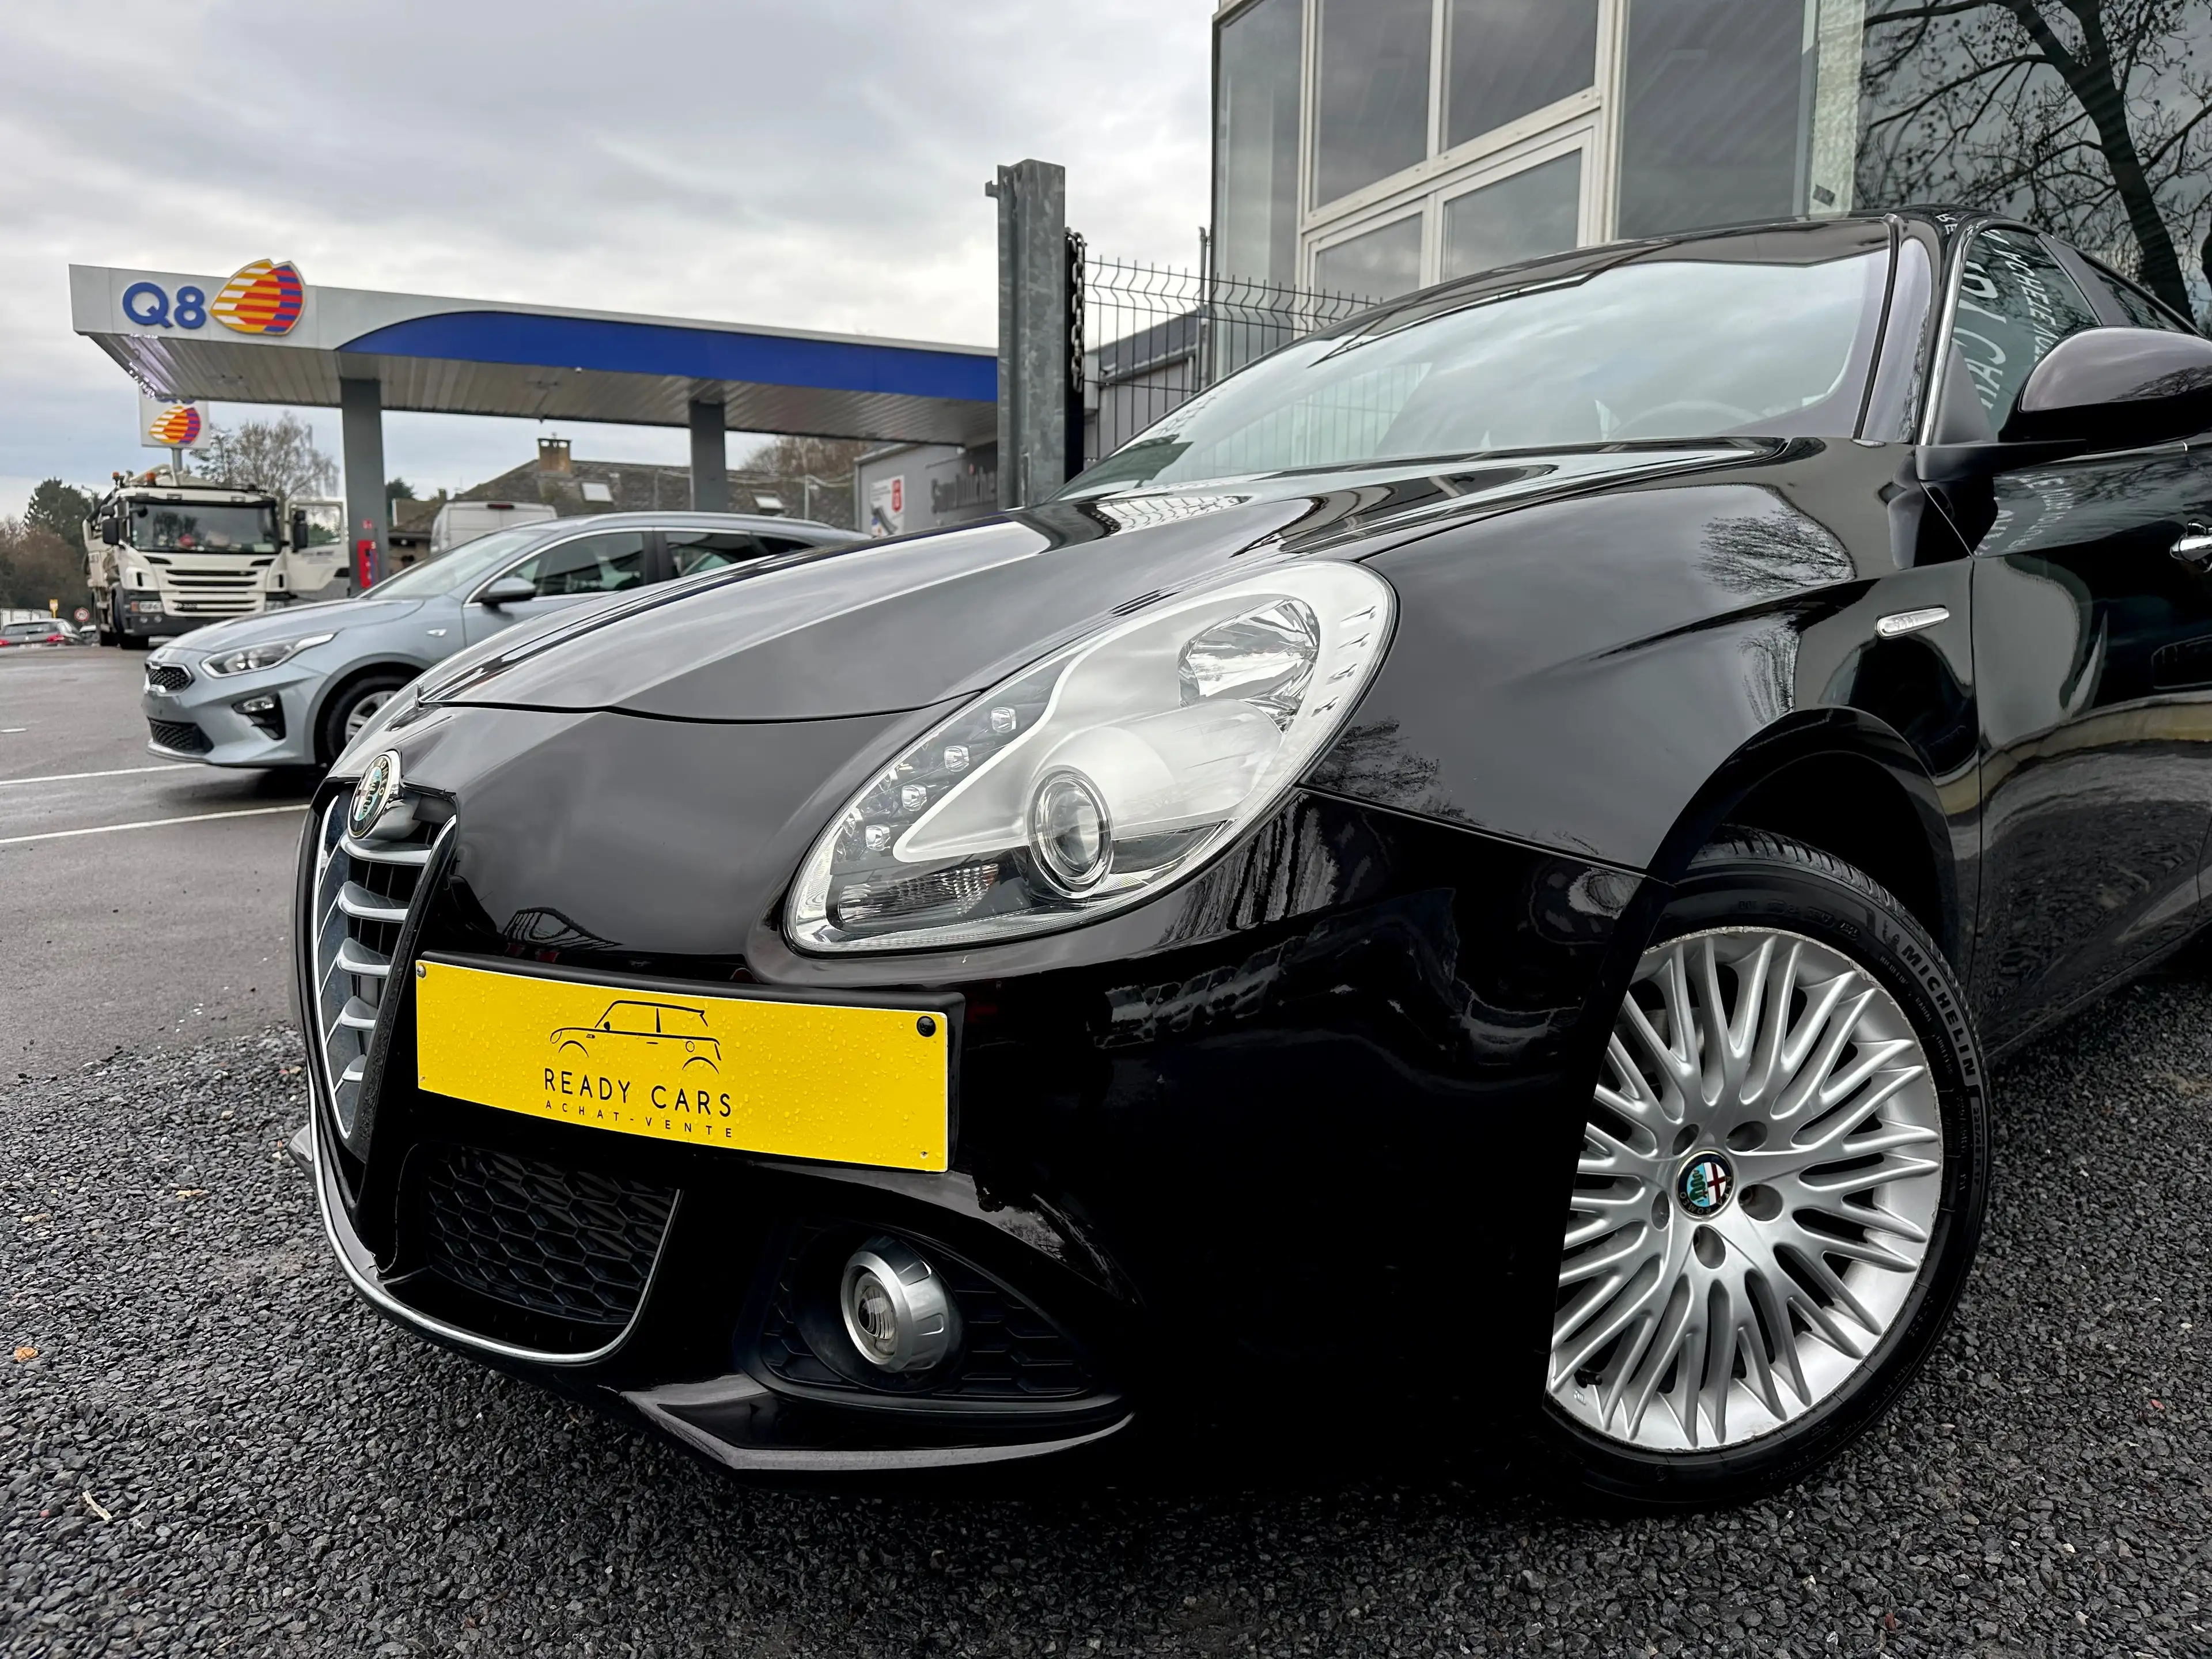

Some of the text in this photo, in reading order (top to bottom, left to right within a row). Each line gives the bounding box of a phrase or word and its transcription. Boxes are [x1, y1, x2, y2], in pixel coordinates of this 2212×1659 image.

[122, 282, 206, 329] Q8
[1901, 944, 1976, 1077] MICHELIN
[545, 1067, 731, 1118] READY CARS
[545, 1100, 732, 1138] ACHAT-VENTE
[1679, 1191, 1711, 1214] ROMEO
[1714, 1175, 1732, 1206] ALFA
